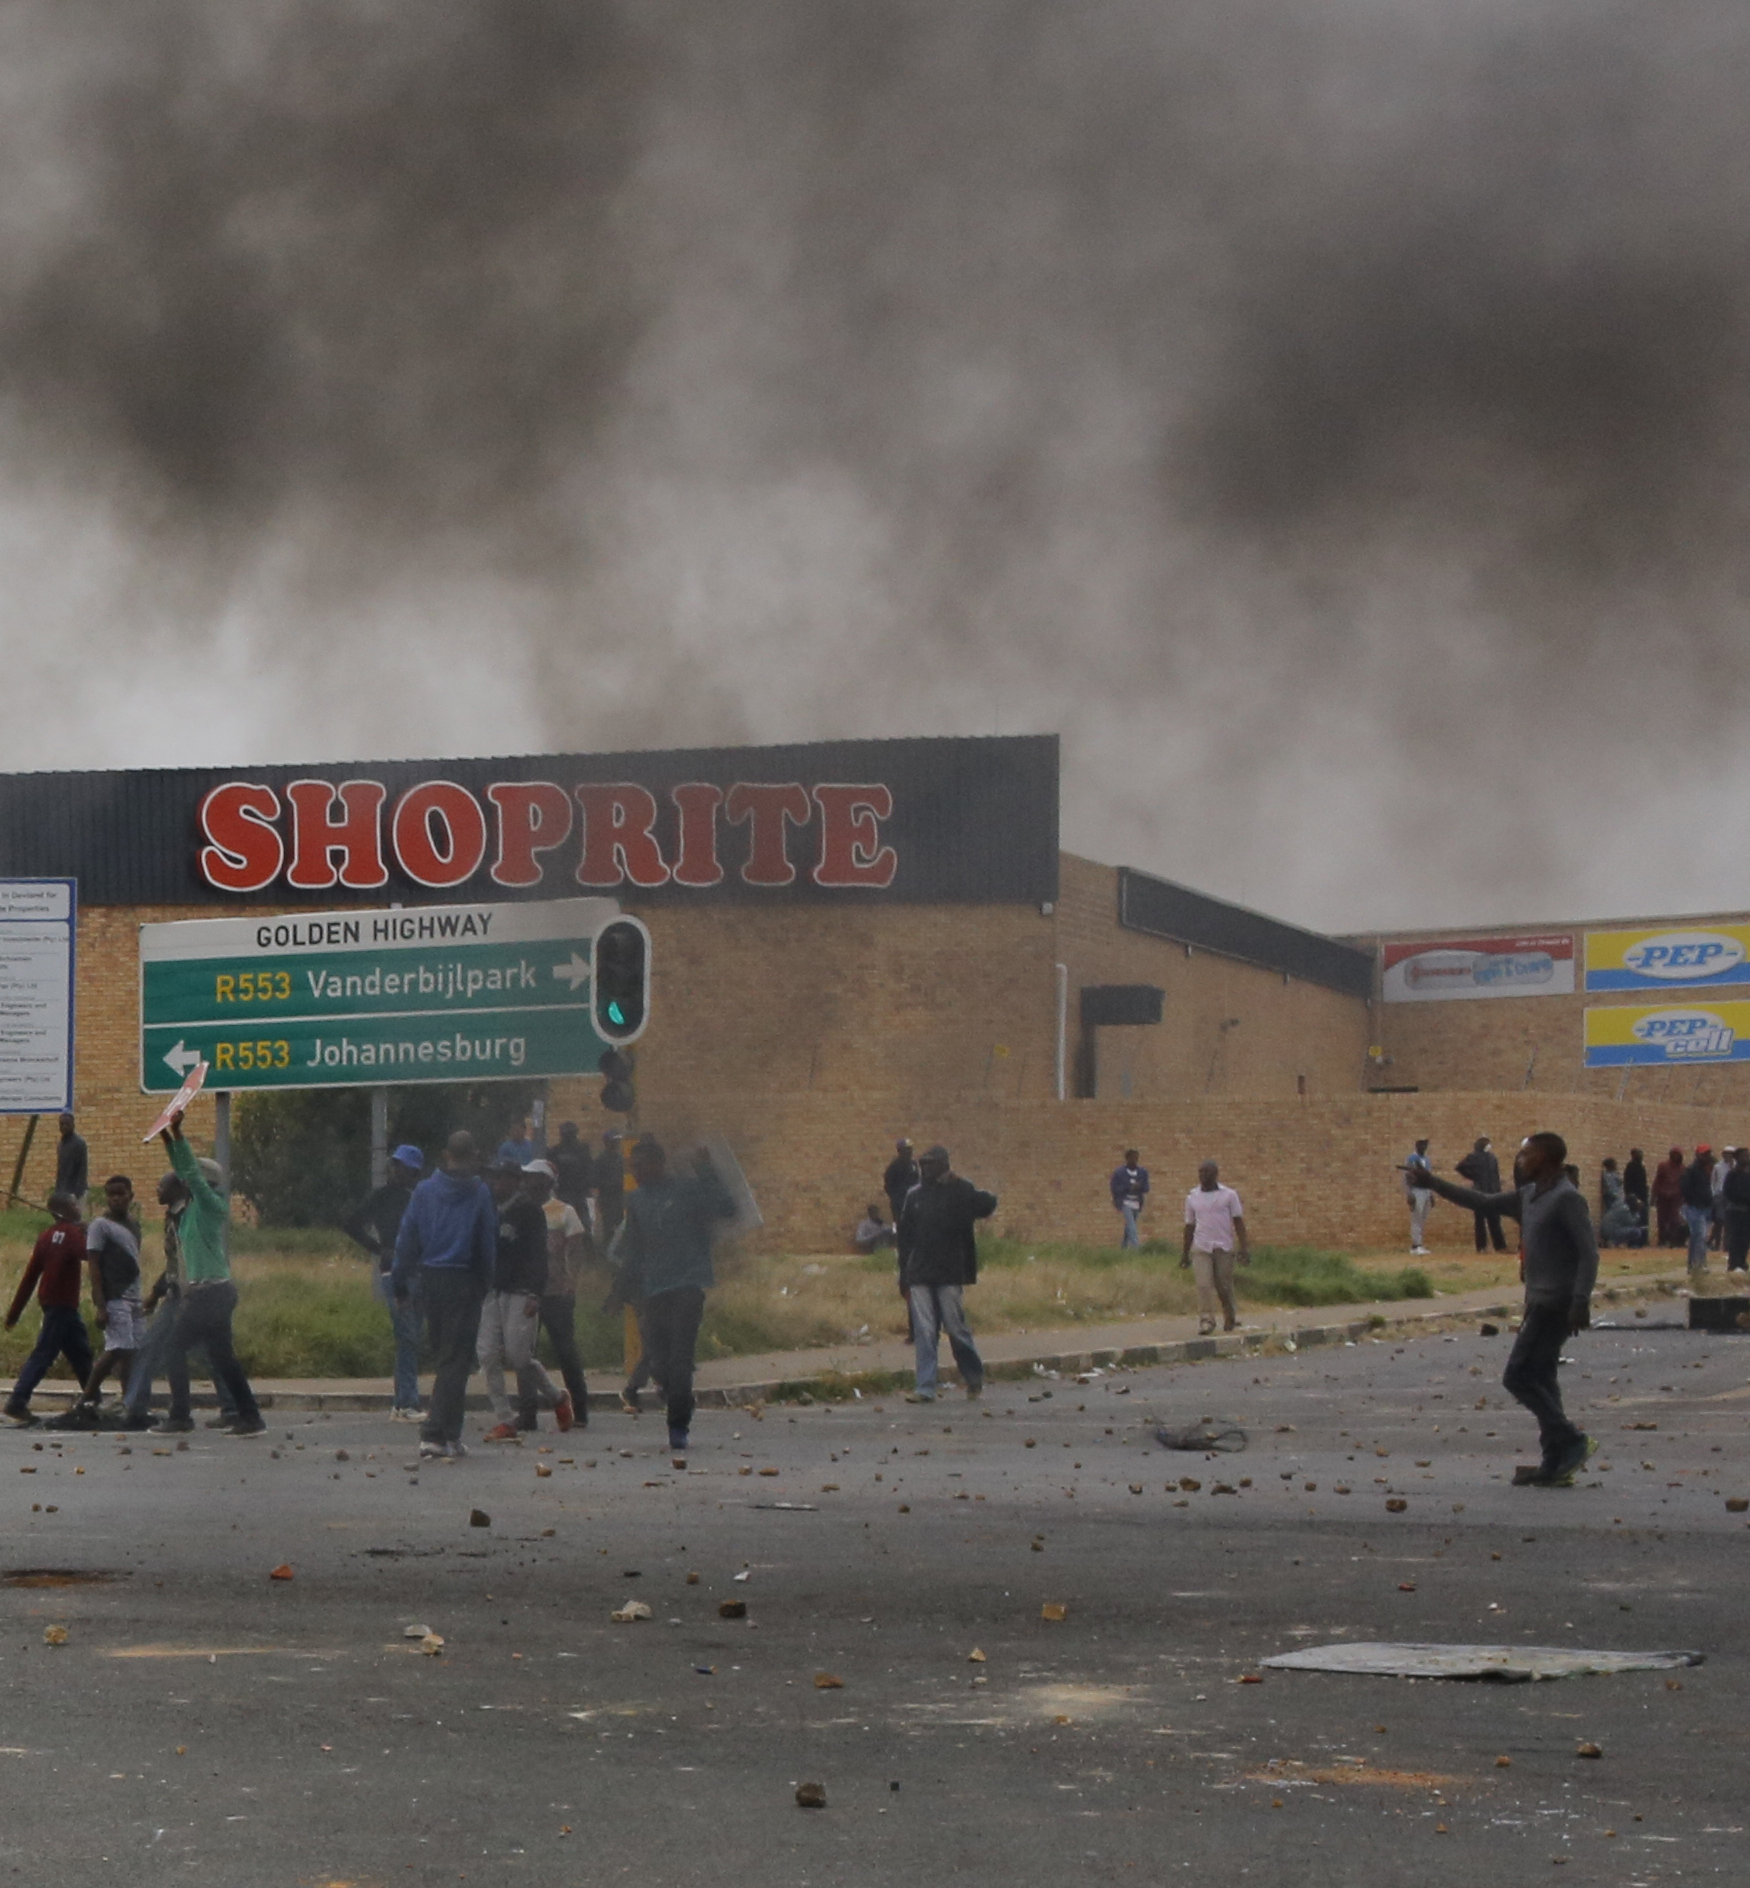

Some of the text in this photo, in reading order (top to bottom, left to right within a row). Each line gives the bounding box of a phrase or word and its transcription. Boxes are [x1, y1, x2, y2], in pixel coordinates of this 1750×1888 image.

[198, 778, 898, 892] SHOPRITE
[255, 912, 495, 949] GOLDEN HIGHWAY
[1634, 941, 1727, 968] PEP
[215, 959, 538, 1003] R553 Vanderbijlpark
[1639, 1018, 1709, 1038] PEP
[1665, 1027, 1735, 1057] cell
[215, 1033, 527, 1071] R553 Johannesburg
